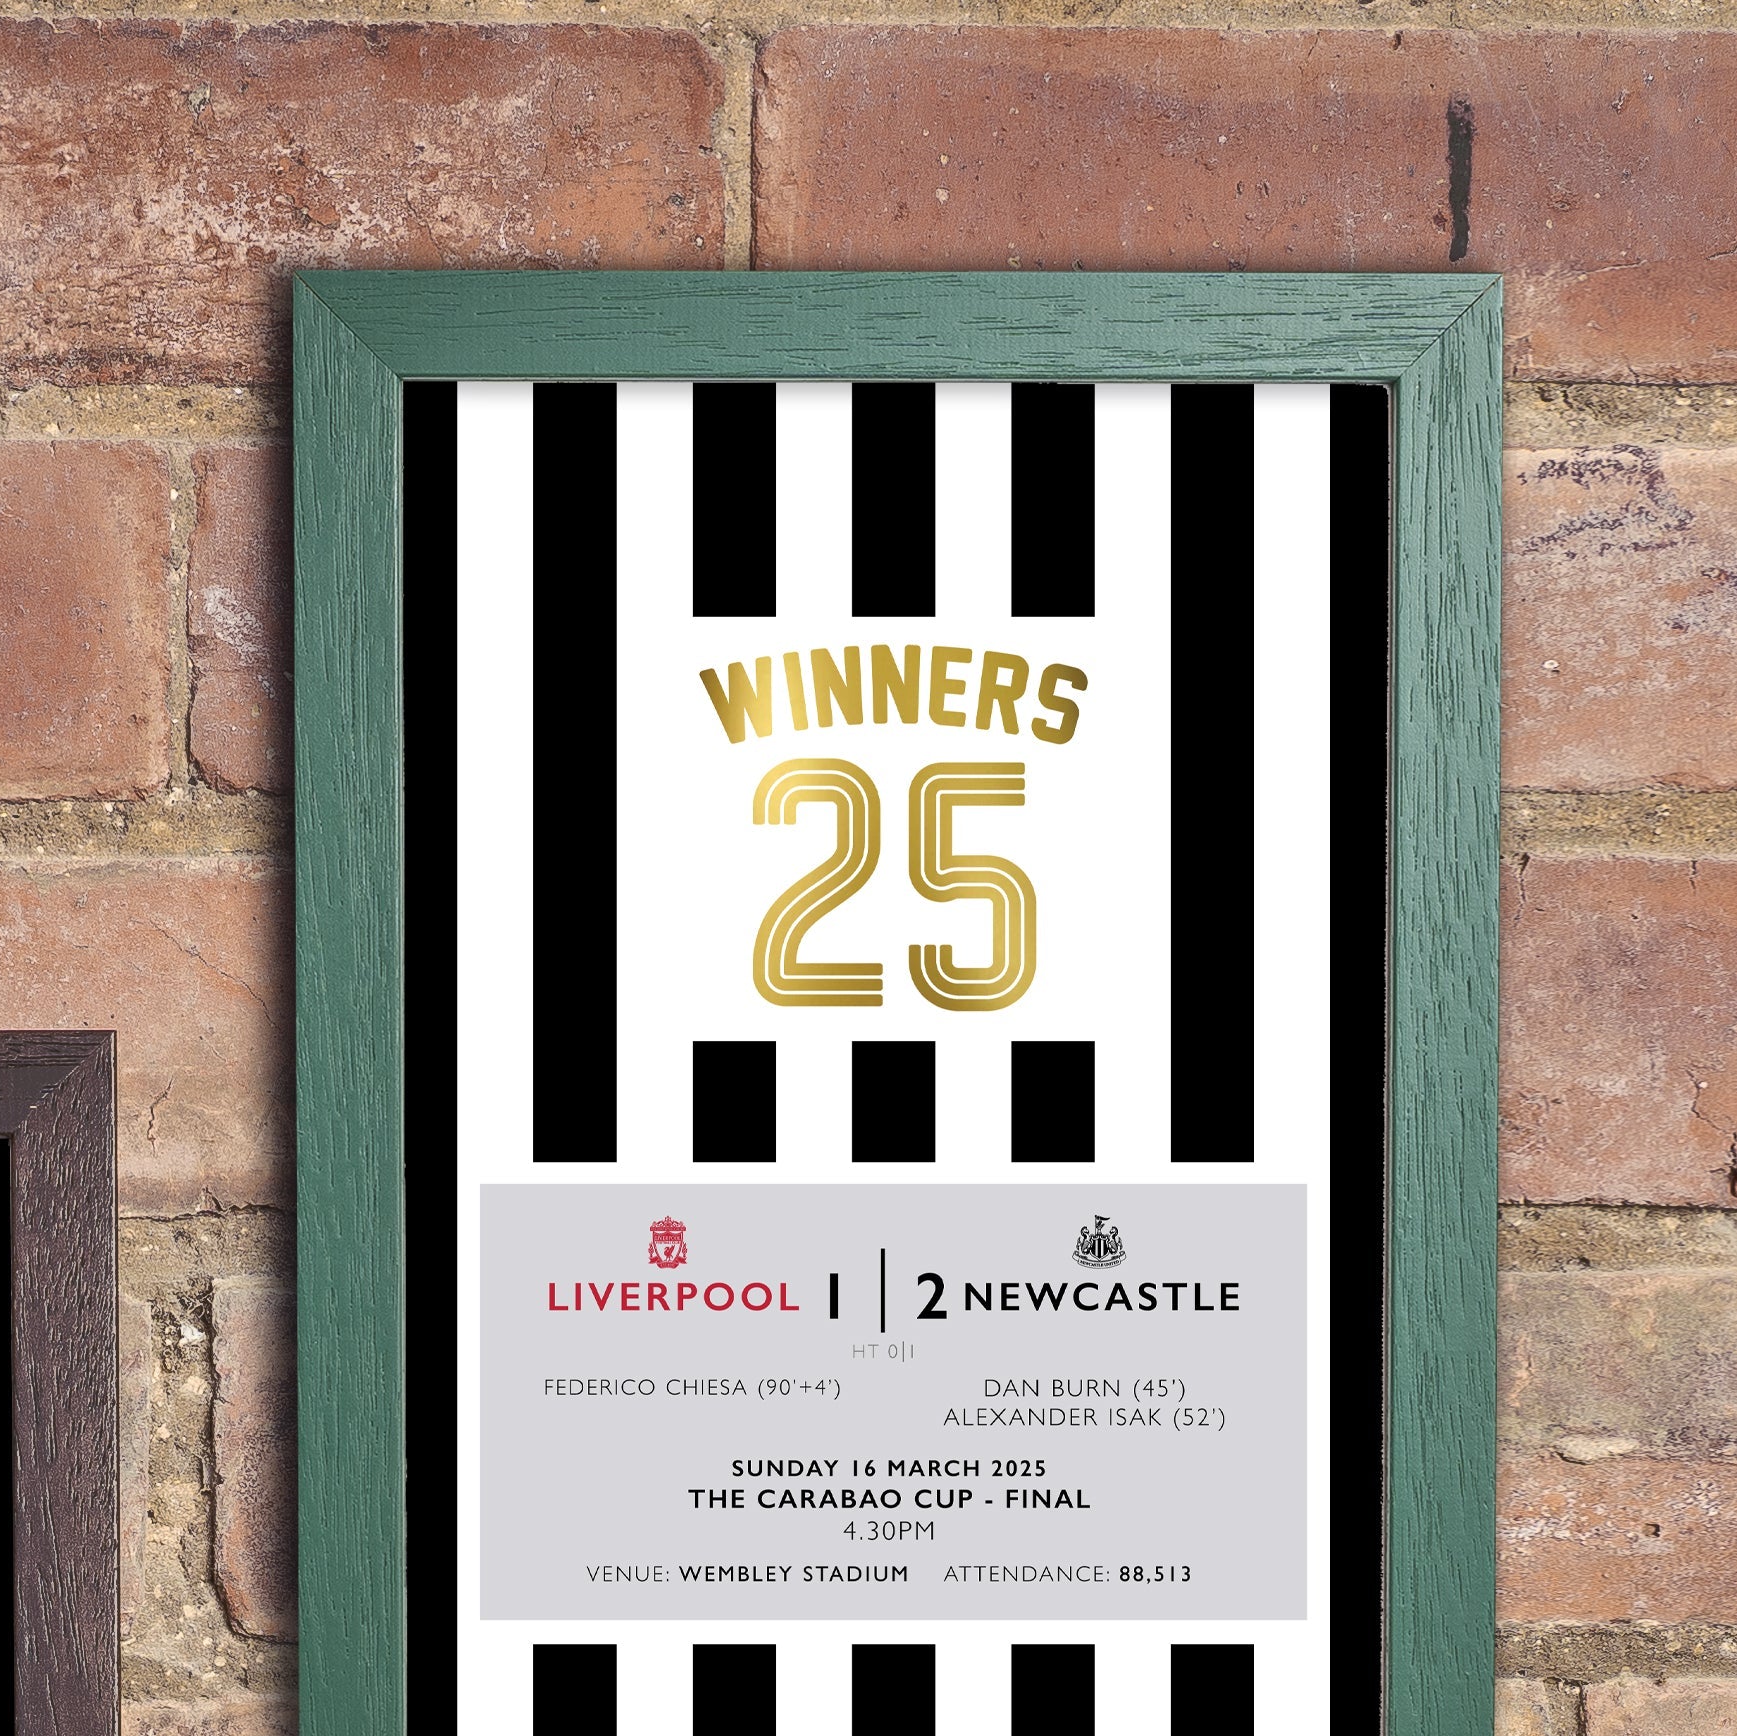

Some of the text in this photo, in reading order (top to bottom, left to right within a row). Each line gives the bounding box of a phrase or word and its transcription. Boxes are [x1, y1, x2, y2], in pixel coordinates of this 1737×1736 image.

[699, 644, 1088, 744] WINNERS
[753, 758, 1036, 1011] 25
[548, 1272, 1239, 1320] LIVERPOOL 1 2 NEWCASTLE
[852, 1343, 880, 1359] HT
[545, 1377, 655, 1395] FEDERICO
[666, 1377, 747, 1395] CHIESA
[985, 1377, 1186, 1403] DAN BURN (45')
[944, 1407, 1226, 1432] ALEXANDER ISAK (52')
[732, 1459, 1047, 1478] SUNDAY 16 MARCH 2025
[688, 1488, 744, 1509] THE
[758, 1488, 902, 1509] CARABAO
[914, 1488, 973, 1509] CUP
[1006, 1488, 1090, 1509] FINAL
[843, 1520, 935, 1541] 4.30PM
[586, 1565, 908, 1583] VENUE: WEMBLEY STADIUM
[944, 1565, 1191, 1585] ATTENDANCE: 88,513
